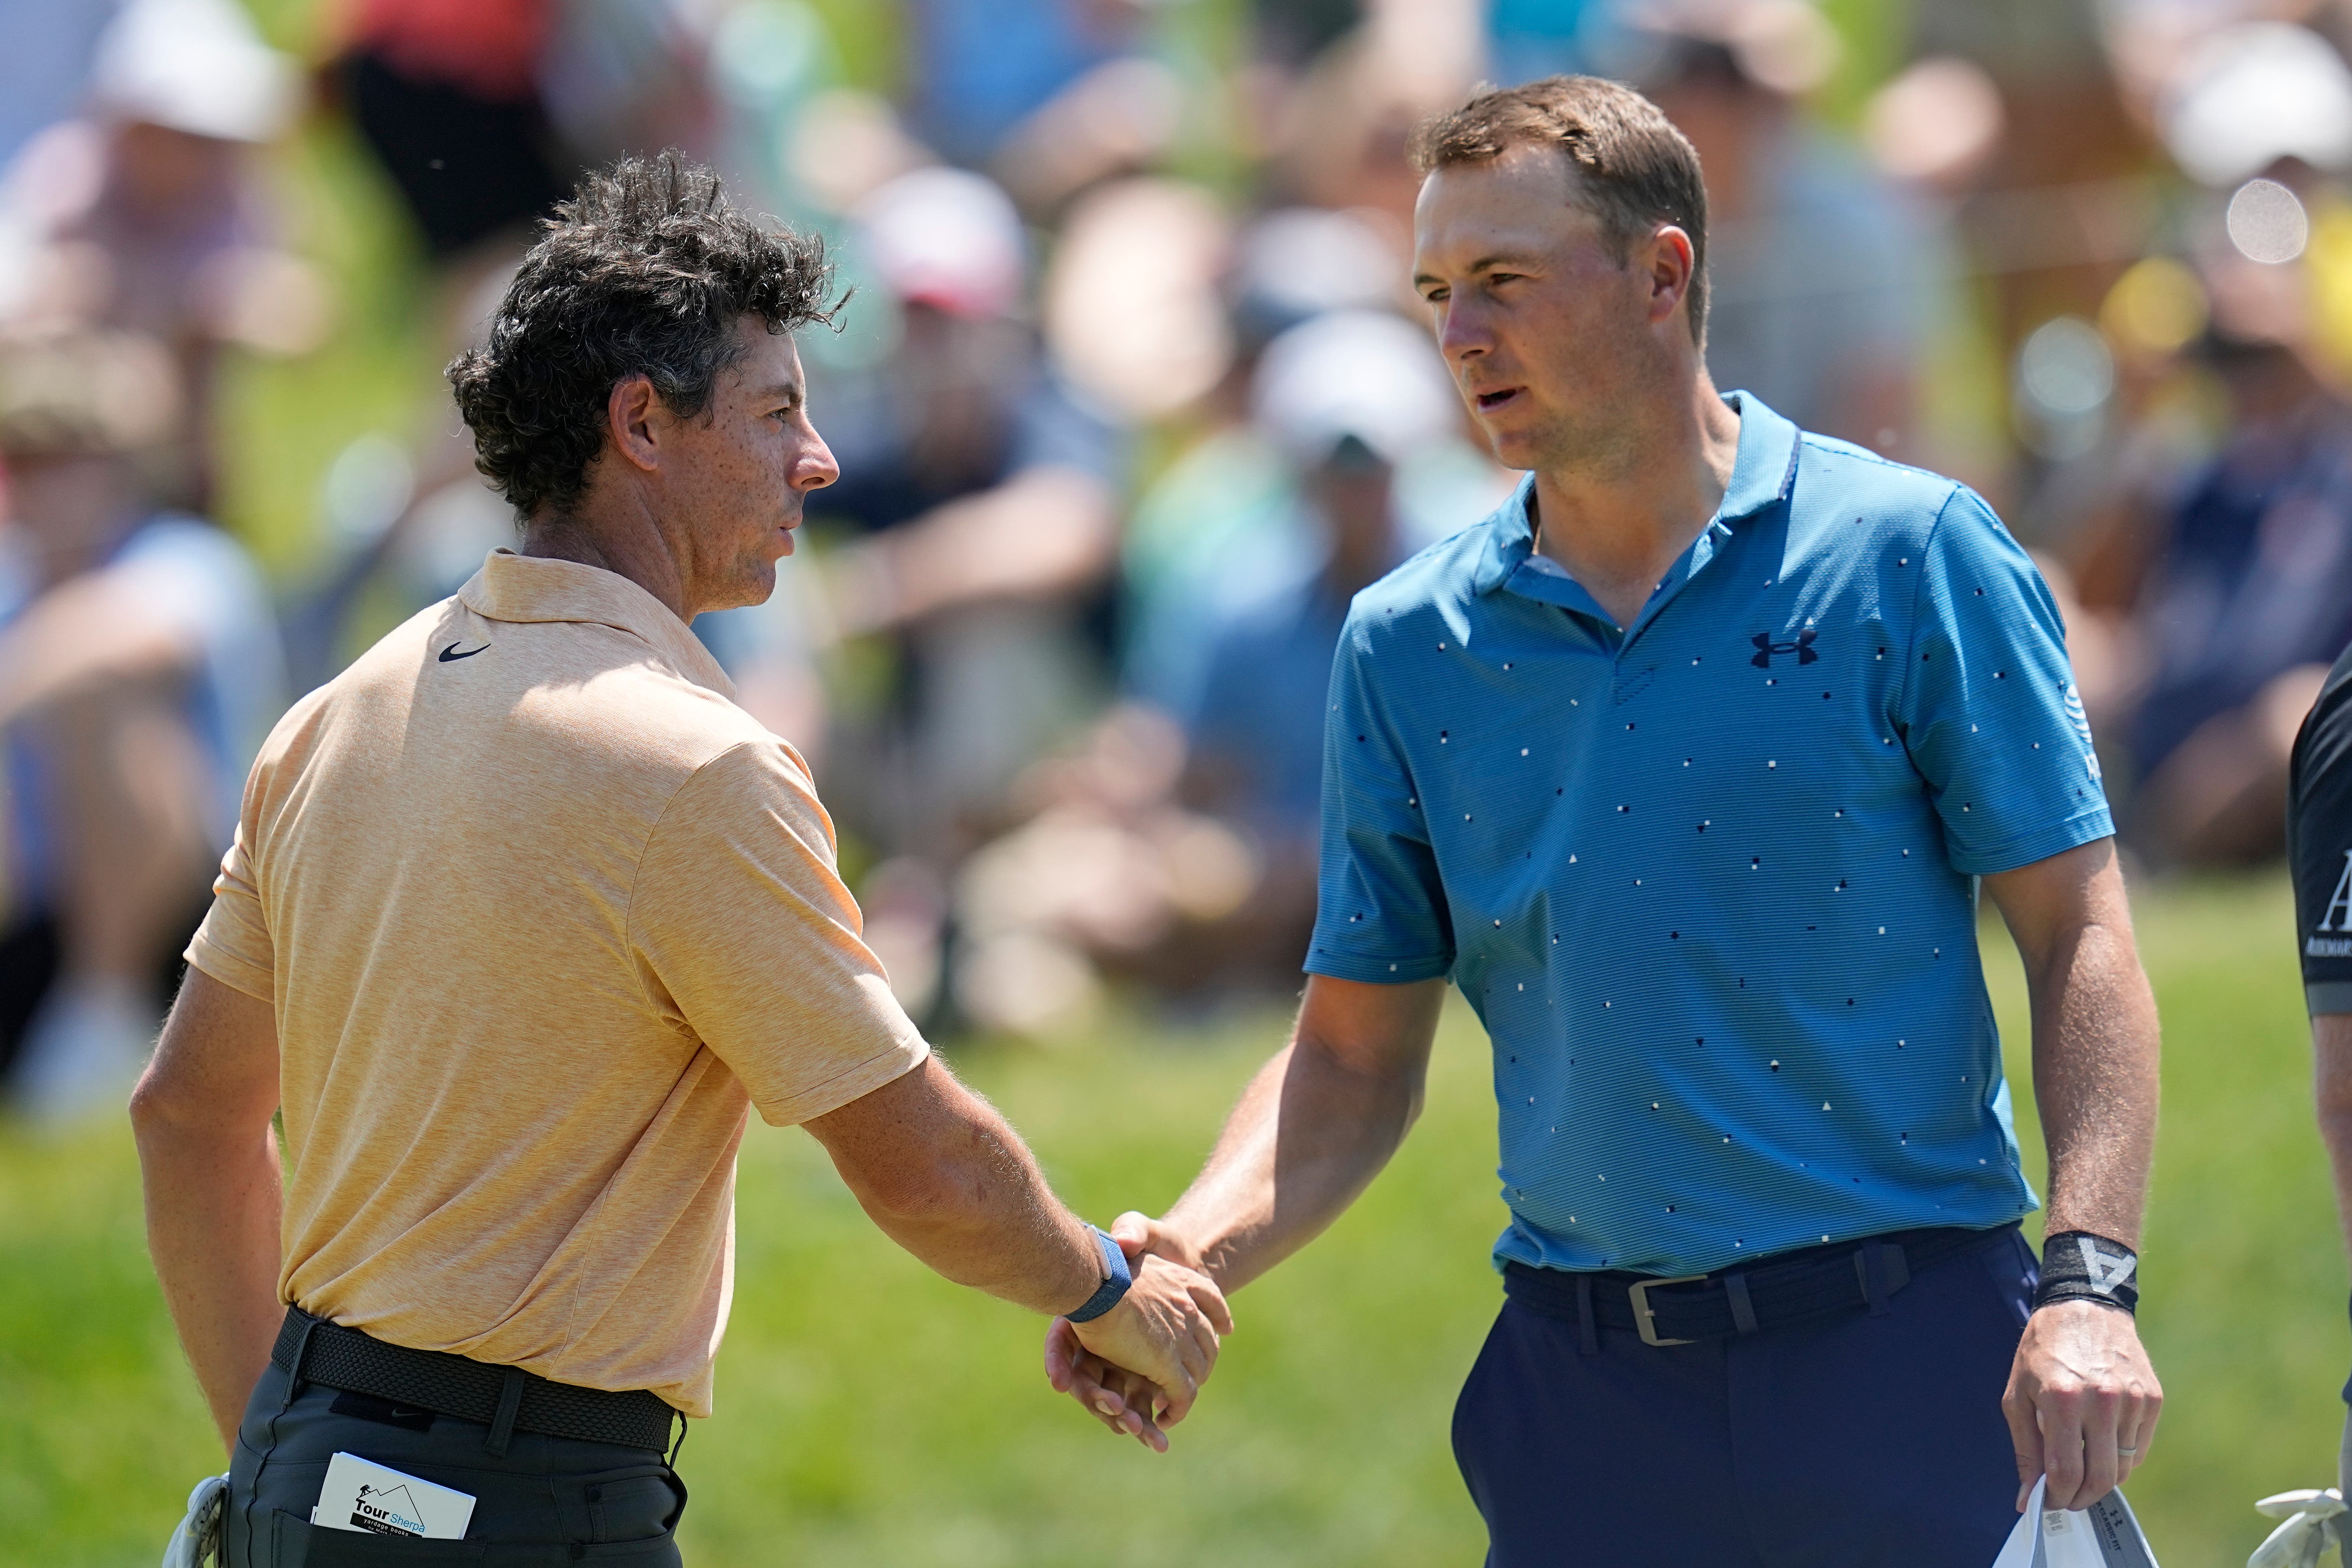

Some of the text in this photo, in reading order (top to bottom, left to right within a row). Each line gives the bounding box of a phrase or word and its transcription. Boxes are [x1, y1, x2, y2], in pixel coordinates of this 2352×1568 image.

[356, 1498, 425, 1533] Tour Sherpa
[364, 1518, 409, 1537] yardage books
